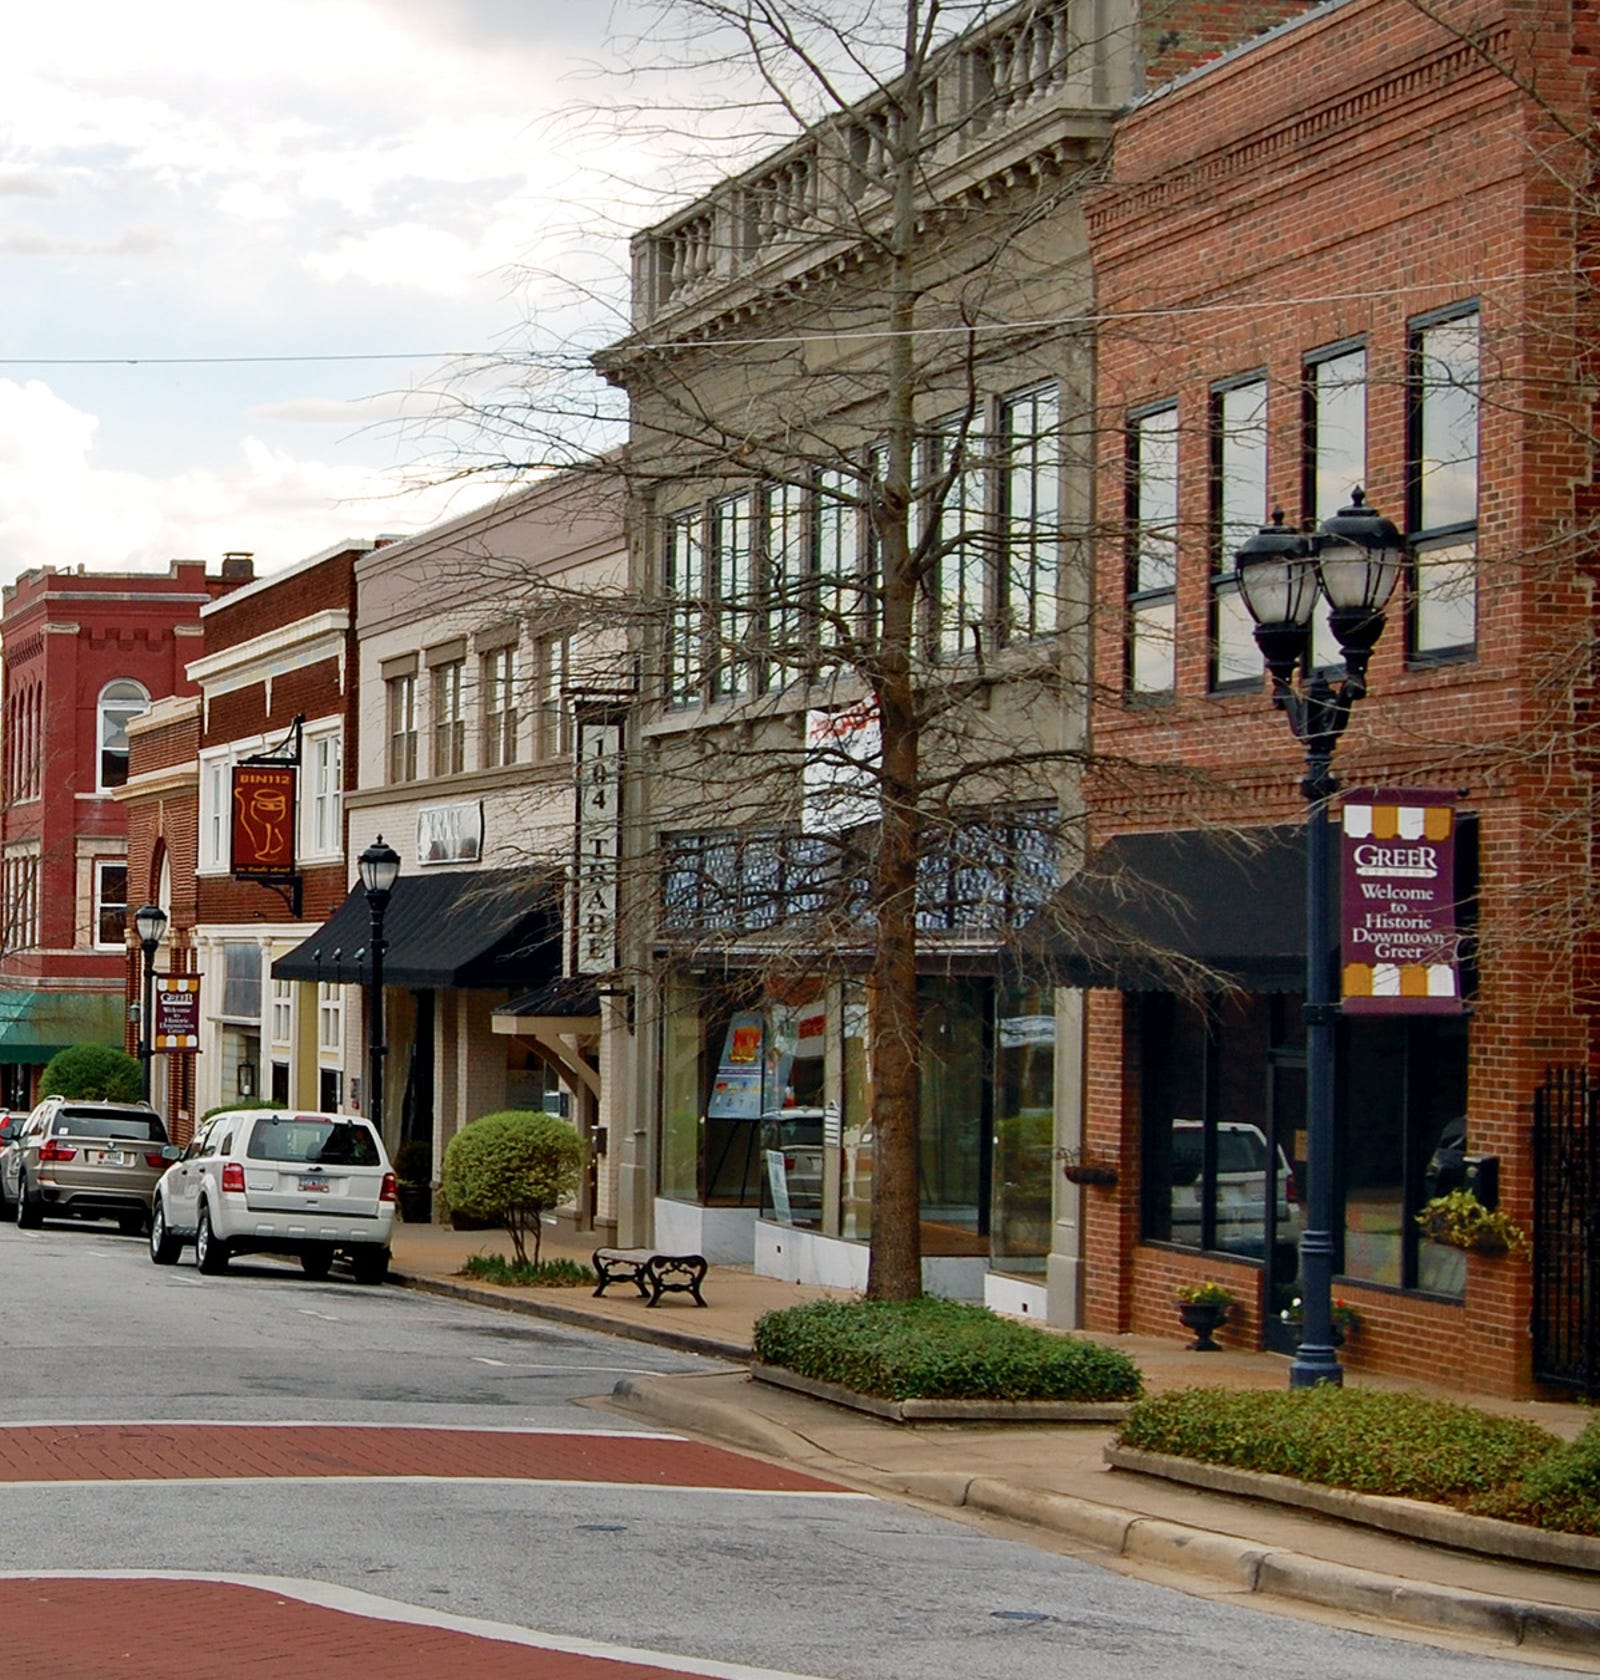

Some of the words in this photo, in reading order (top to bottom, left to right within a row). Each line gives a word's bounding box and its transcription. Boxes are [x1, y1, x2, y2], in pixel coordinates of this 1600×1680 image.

[591, 738, 606, 810] 104
[1353, 844, 1439, 869] GREER
[586, 838, 609, 959] TRADE
[1360, 883, 1435, 900] Welcome
[1390, 902, 1408, 914] to
[1365, 913, 1432, 929] Historic
[1352, 927, 1445, 944] Downtown
[1374, 943, 1425, 958] Greer
